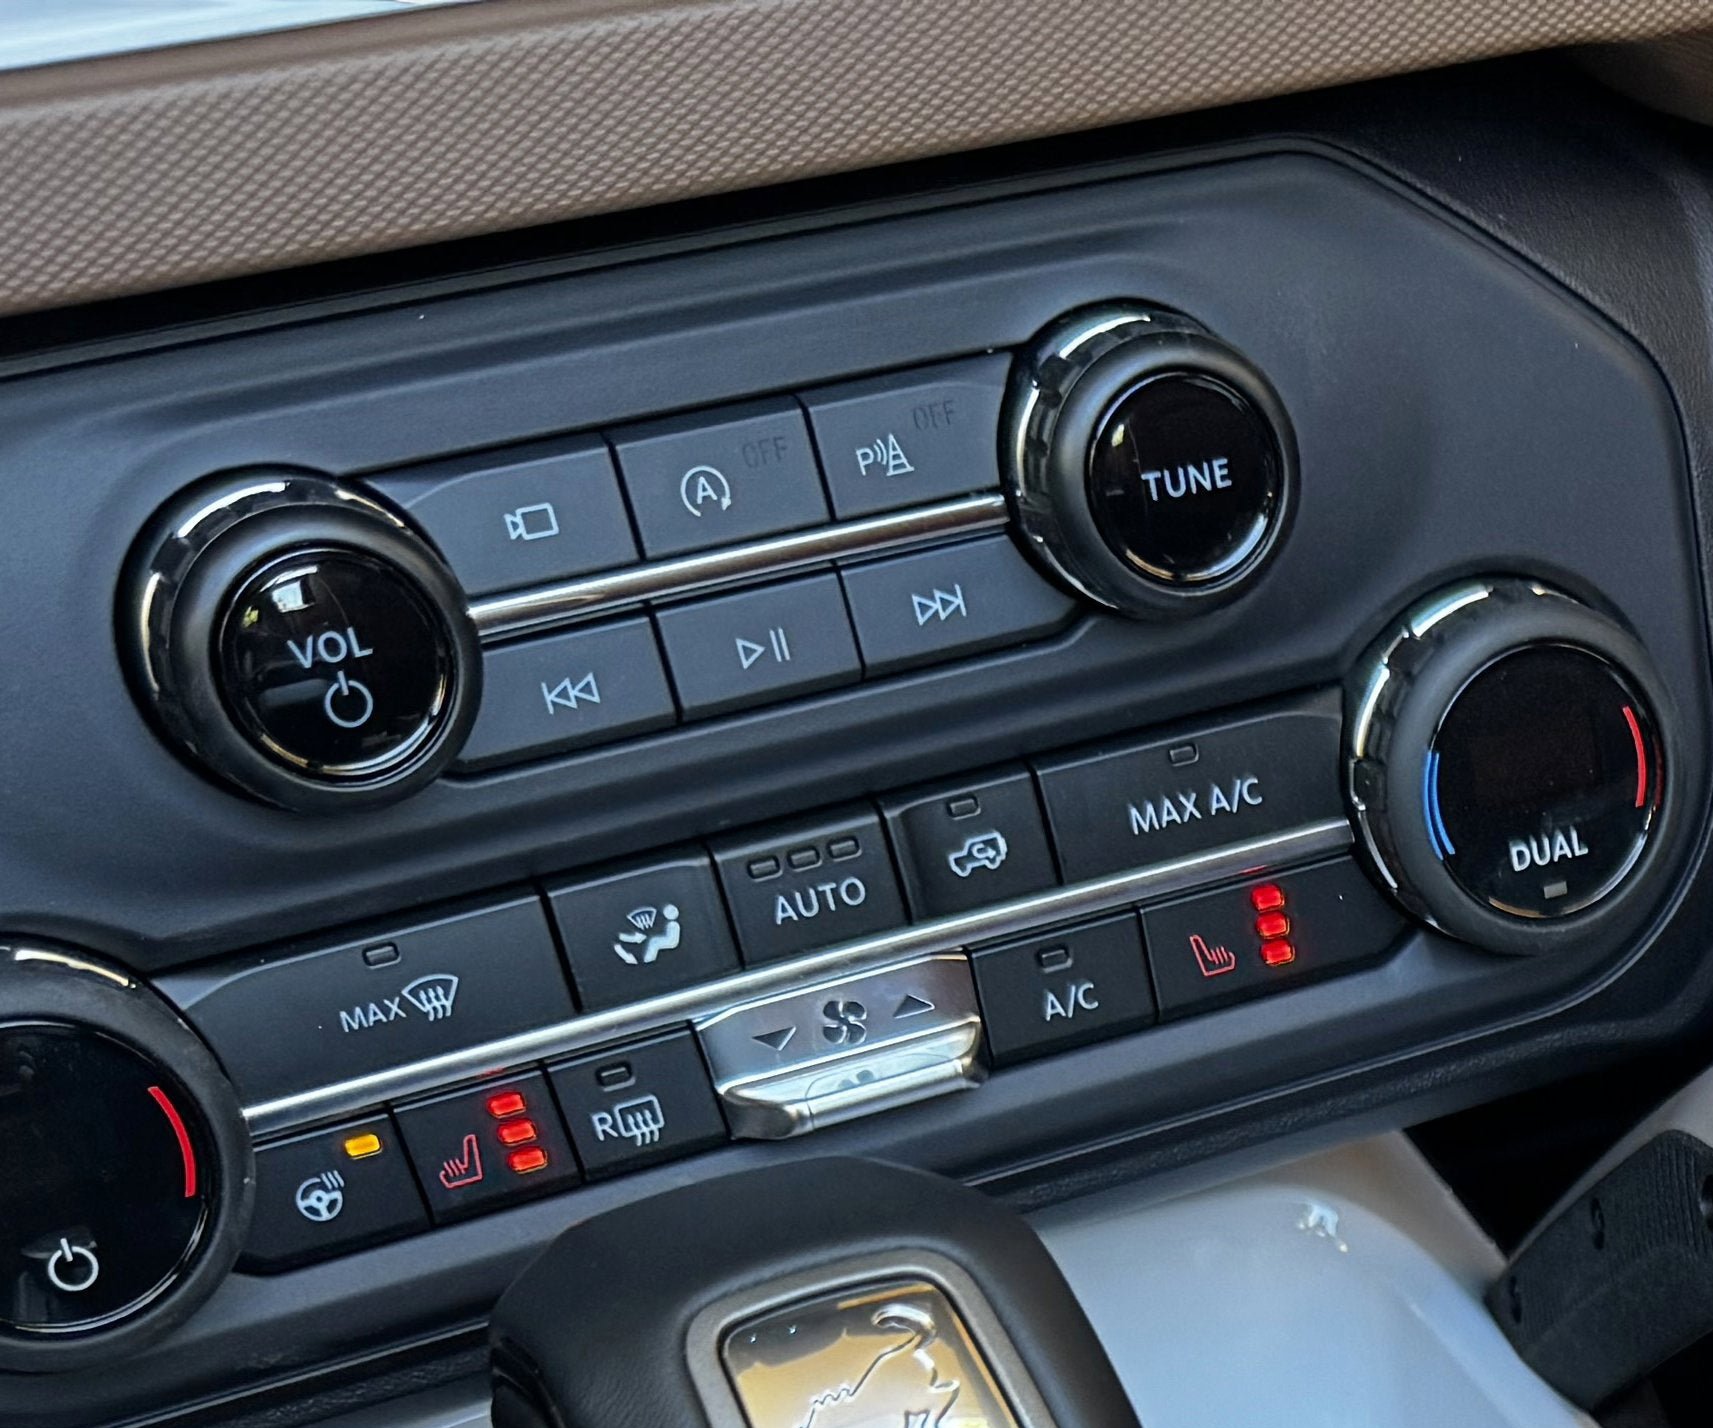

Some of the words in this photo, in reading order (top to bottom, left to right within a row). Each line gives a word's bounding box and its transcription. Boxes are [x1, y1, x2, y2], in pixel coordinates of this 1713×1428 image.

[912, 401, 957, 431] OFF
[740, 435, 788, 468] OFF
[1139, 455, 1233, 502] TUNE
[287, 626, 374, 672] VOL
[1128, 793, 1202, 835] MAX
[1208, 778, 1264, 821] A/C
[1509, 829, 1590, 874] DUAL
[774, 877, 868, 926] AUTO
[339, 996, 407, 1034] MAX
[1041, 982, 1100, 1023] A/C
